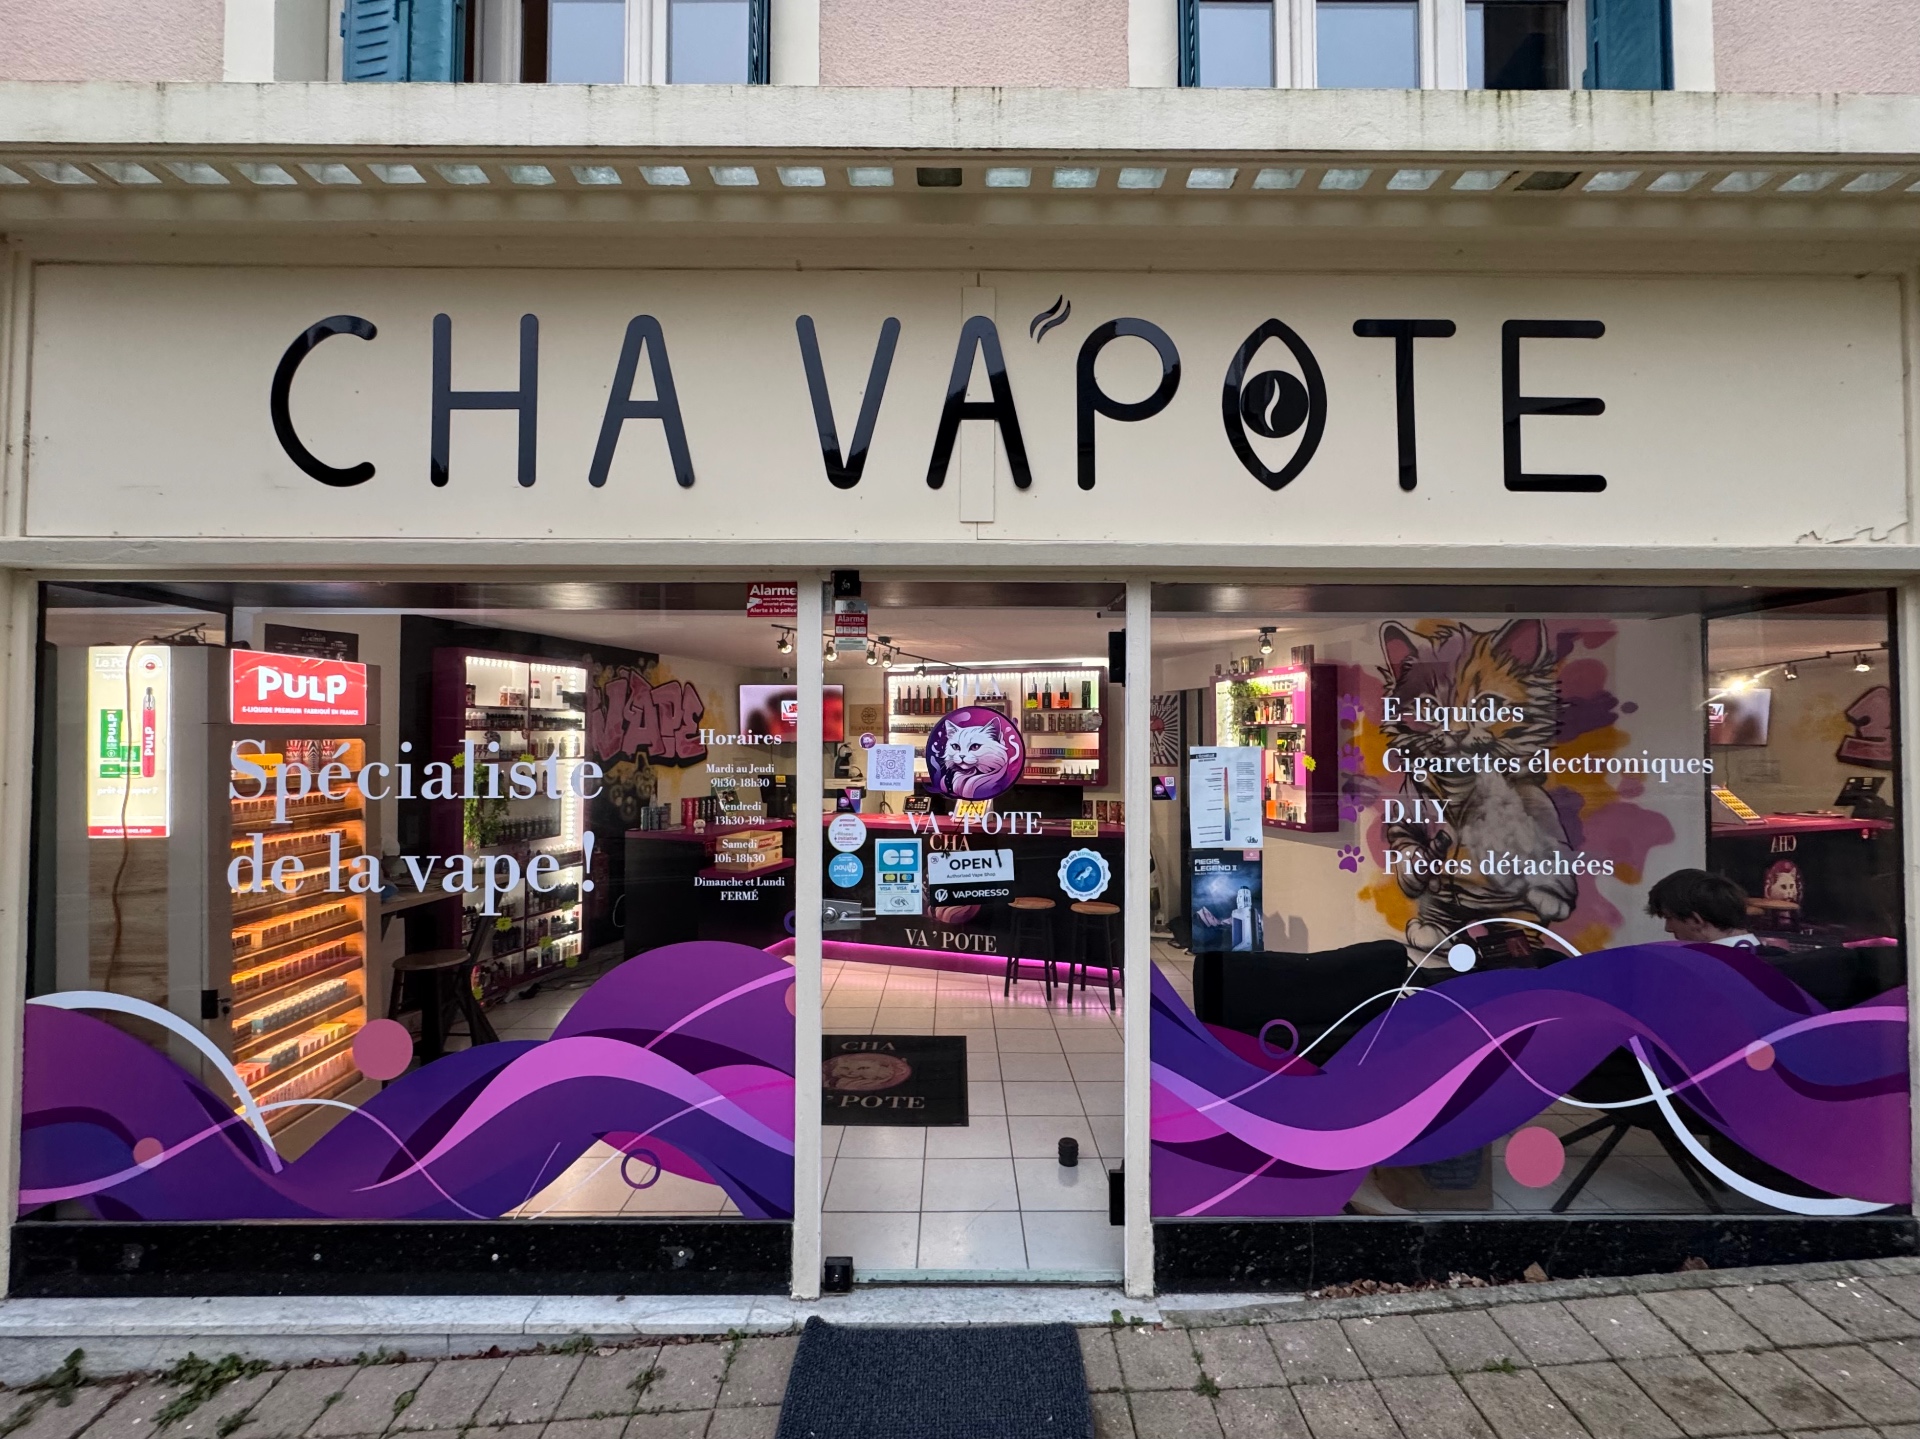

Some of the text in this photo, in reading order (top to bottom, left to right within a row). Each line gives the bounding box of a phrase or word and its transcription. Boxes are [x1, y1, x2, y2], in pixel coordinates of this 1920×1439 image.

[270, 312, 697, 488] CHA
[750, 584, 797, 596] Alarme
[838, 614, 865, 622] Alarme
[111, 657, 124, 668] Po
[258, 665, 347, 704] PULP
[242, 706, 273, 714] E-LIQUIDE
[274, 707, 303, 715] PREMIUM
[592, 667, 708, 766] VAPE
[1381, 697, 1524, 731] E-liquides
[107, 714, 118, 743] PULP
[143, 726, 154, 756] PULP
[699, 728, 783, 746] Horaires
[706, 763, 775, 775] Mardi au Jeudi
[1382, 747, 1714, 783] Cigarettes électroniques
[229, 738, 604, 825] Spécialiste
[719, 800, 761, 811] Vendredi
[1382, 798, 1451, 824] D.I.Y
[715, 815, 765, 826] 13h30-19h
[722, 838, 758, 849] Samedi
[929, 834, 970, 851] CHA
[714, 853, 766, 864] 10h-18h30
[950, 857, 993, 871] OPEN
[1383, 849, 1615, 876] Pièces détachées
[228, 832, 305, 893] de
[323, 832, 386, 893] la
[400, 853, 560, 917] vape
[694, 876, 785, 887] Dimanche et Lundi
[720, 888, 759, 901] FERMÉ
[952, 888, 1010, 899] VAPORESSO
[841, 1041, 896, 1051] CHA
